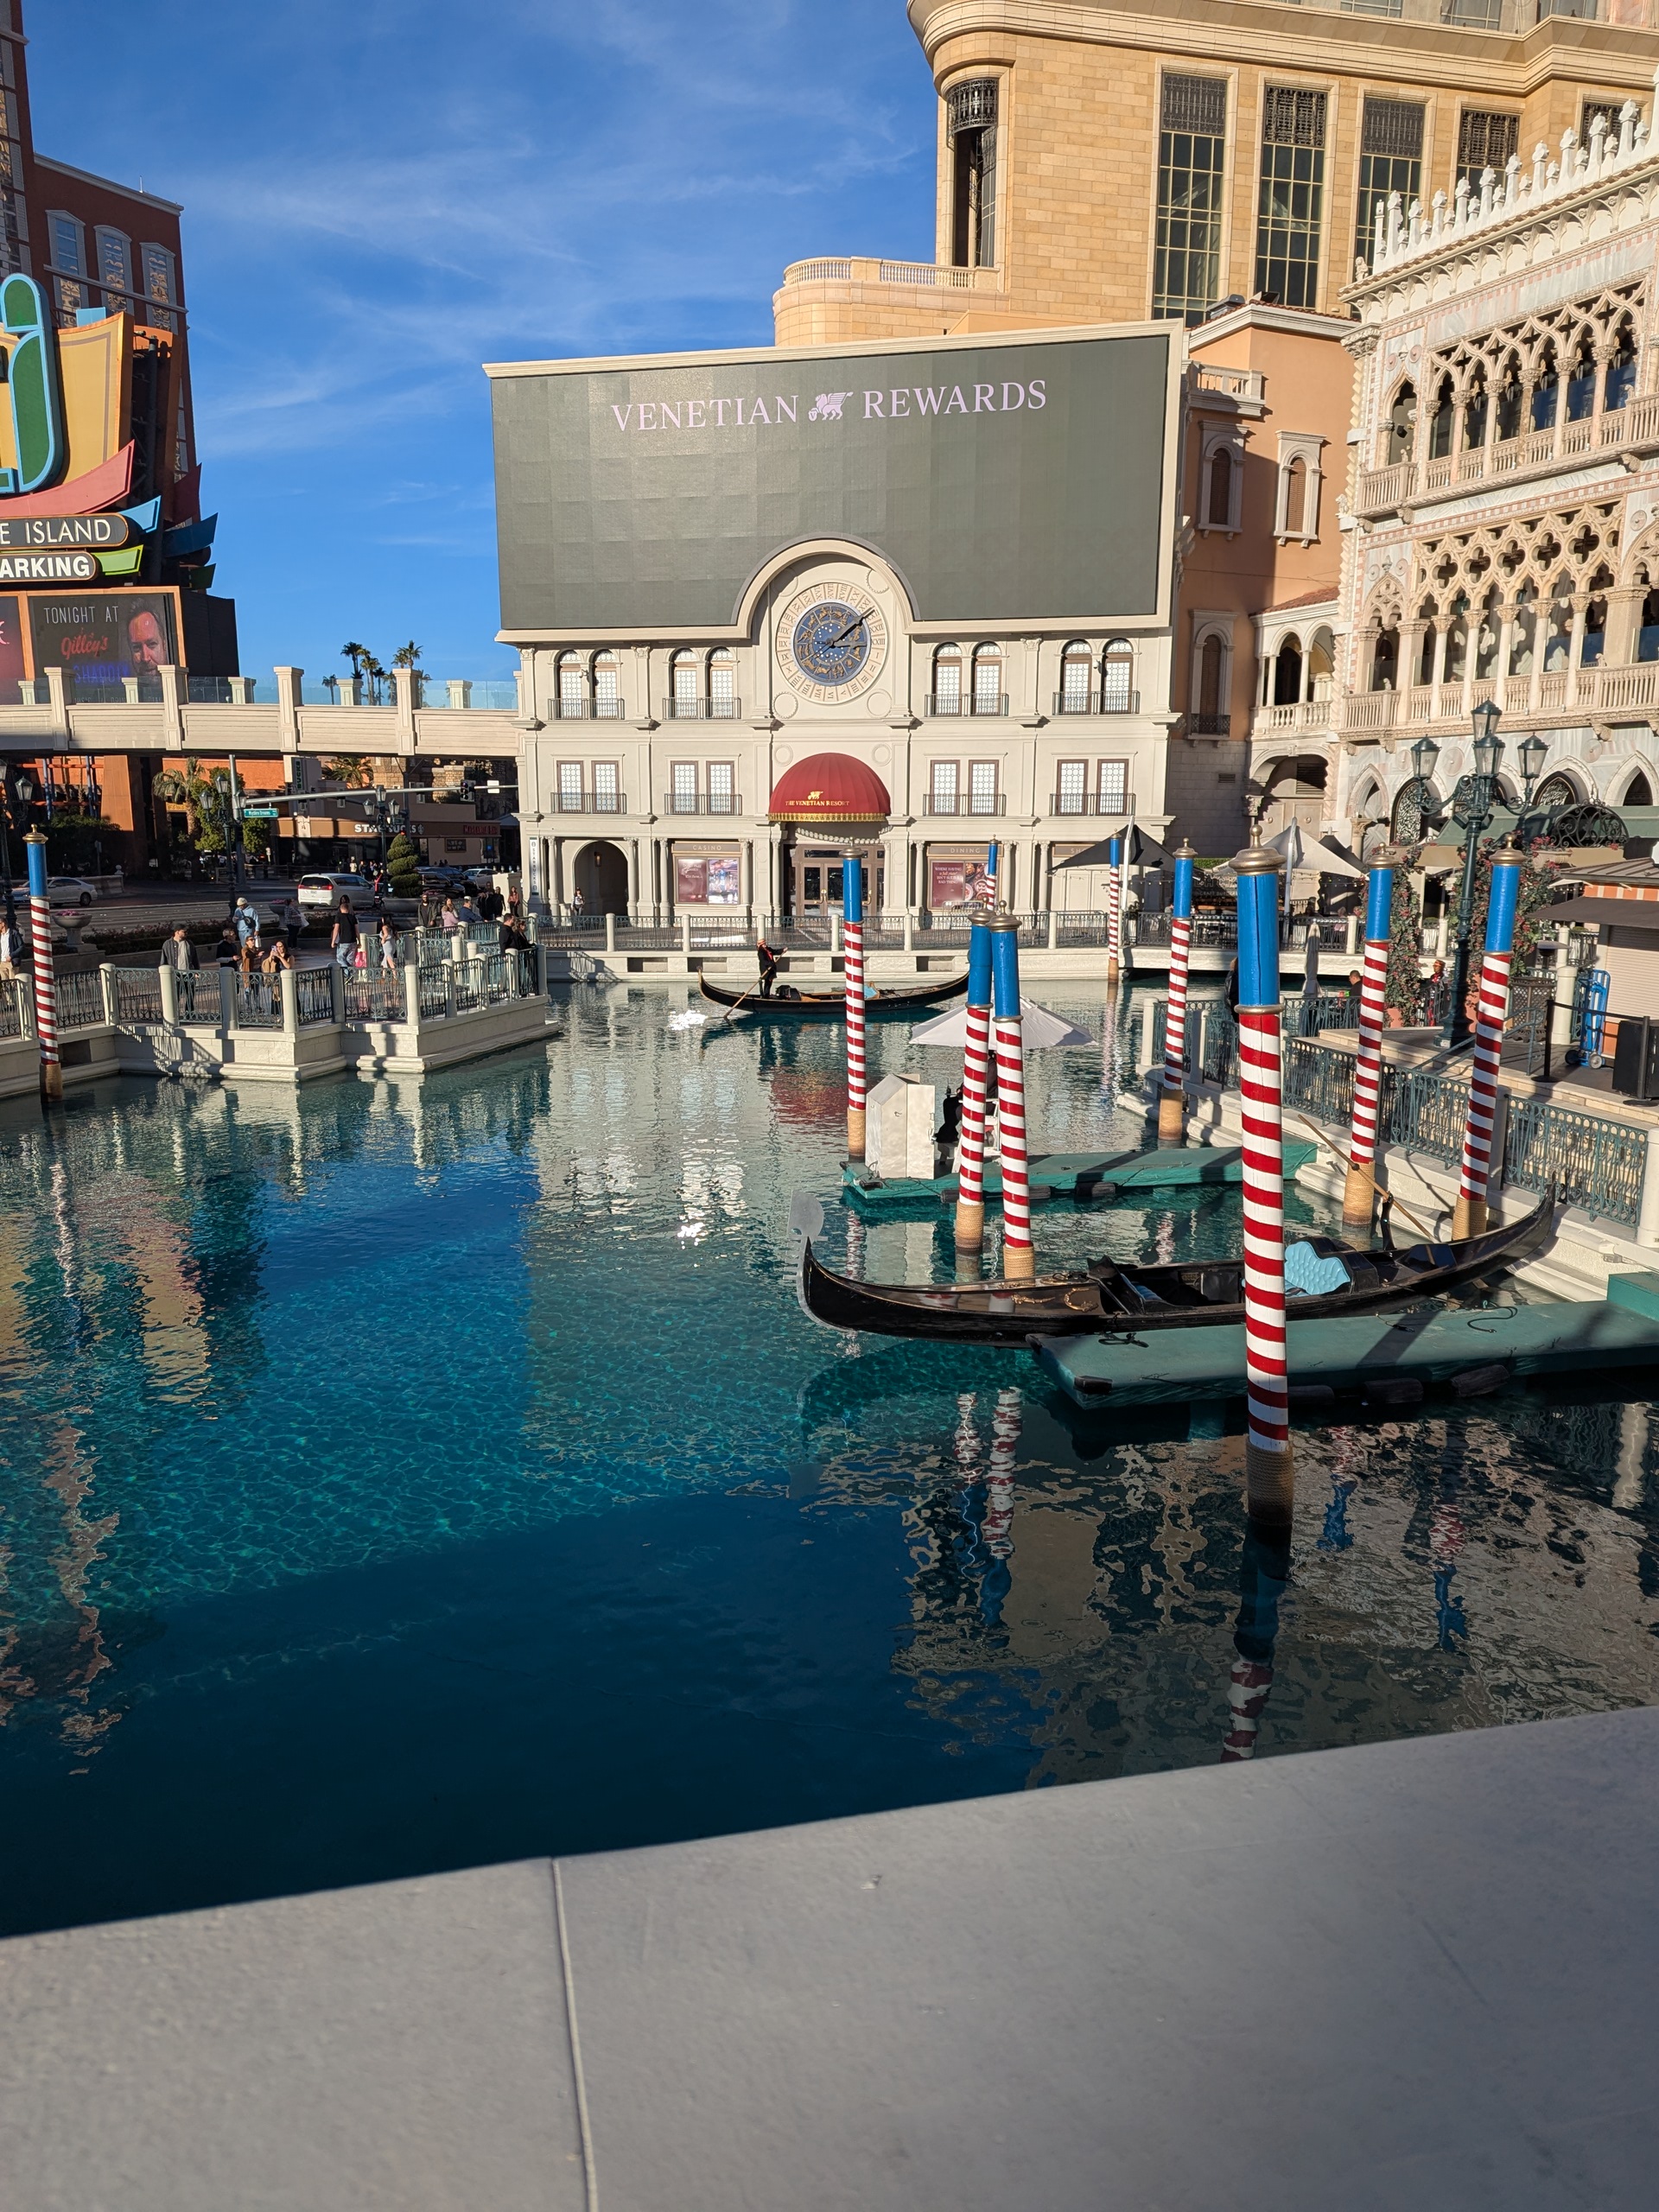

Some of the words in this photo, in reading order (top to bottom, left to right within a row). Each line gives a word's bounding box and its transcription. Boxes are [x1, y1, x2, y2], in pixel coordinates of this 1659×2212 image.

[611, 395, 799, 431] VENETIAN
[862, 380, 1046, 418] REWARDS
[25, 519, 111, 544] ISLAND
[0, 556, 90, 578] ARKING
[44, 607, 95, 624] TONIGHT
[105, 606, 119, 623] AT
